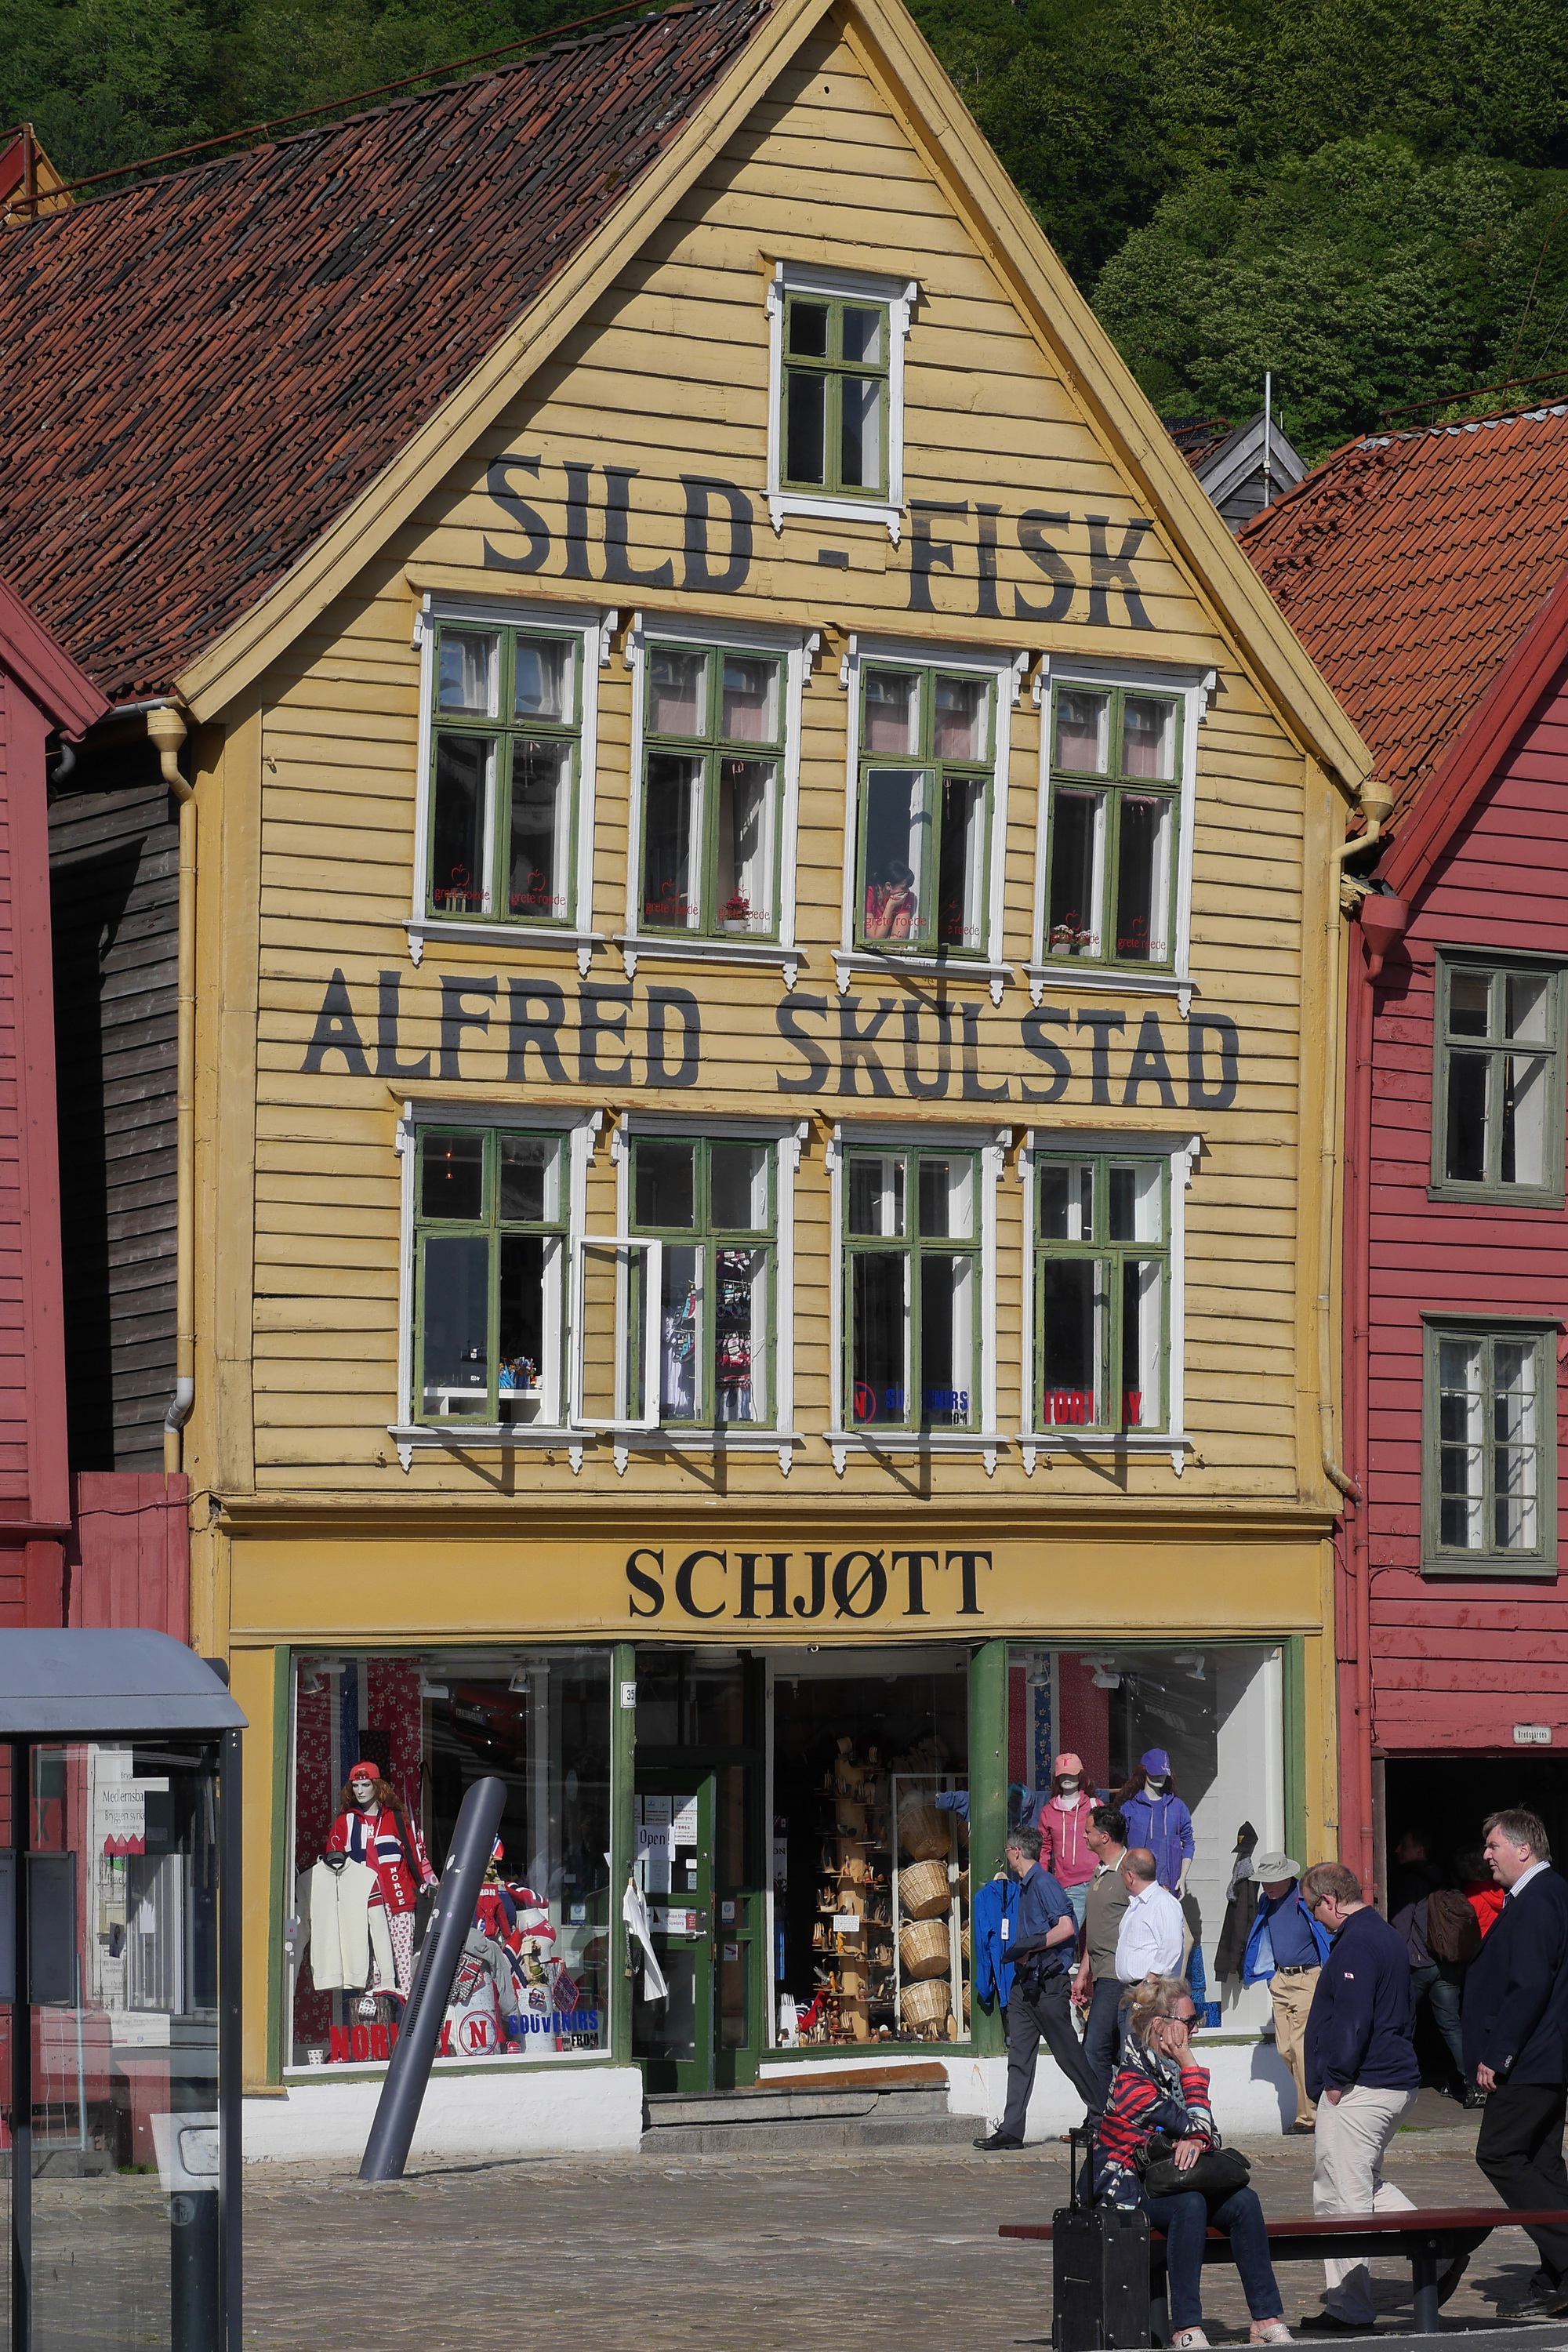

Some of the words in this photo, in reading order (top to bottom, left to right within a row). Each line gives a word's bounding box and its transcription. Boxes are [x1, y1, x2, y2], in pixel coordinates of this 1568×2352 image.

[484, 453, 753, 593] SILD
[907, 499, 1156, 628] FISK
[511, 892, 537, 906] grete
[538, 894, 566, 906] roede
[645, 902, 670, 915] grete
[671, 902, 699, 916] roede
[865, 916, 894, 930] grete
[895, 916, 927, 927] roede
[954, 924, 980, 936] roede
[1117, 937, 1139, 950] grete
[1142, 938, 1166, 950] roede
[301, 967, 701, 1087] ALFRED
[776, 992, 1240, 1110] SKULSTAD
[885, 1388, 968, 1410] SOENIRS
[626, 1548, 993, 1620] SCHJØTT
[626, 1689, 635, 1700] 35
[390, 1866, 405, 1906] NORGE
[507, 2009, 599, 2036] SOUVENIRS
[329, 2019, 452, 2060] NORY
[469, 2020, 487, 2049] N
[571, 2032, 599, 2047] FROM
